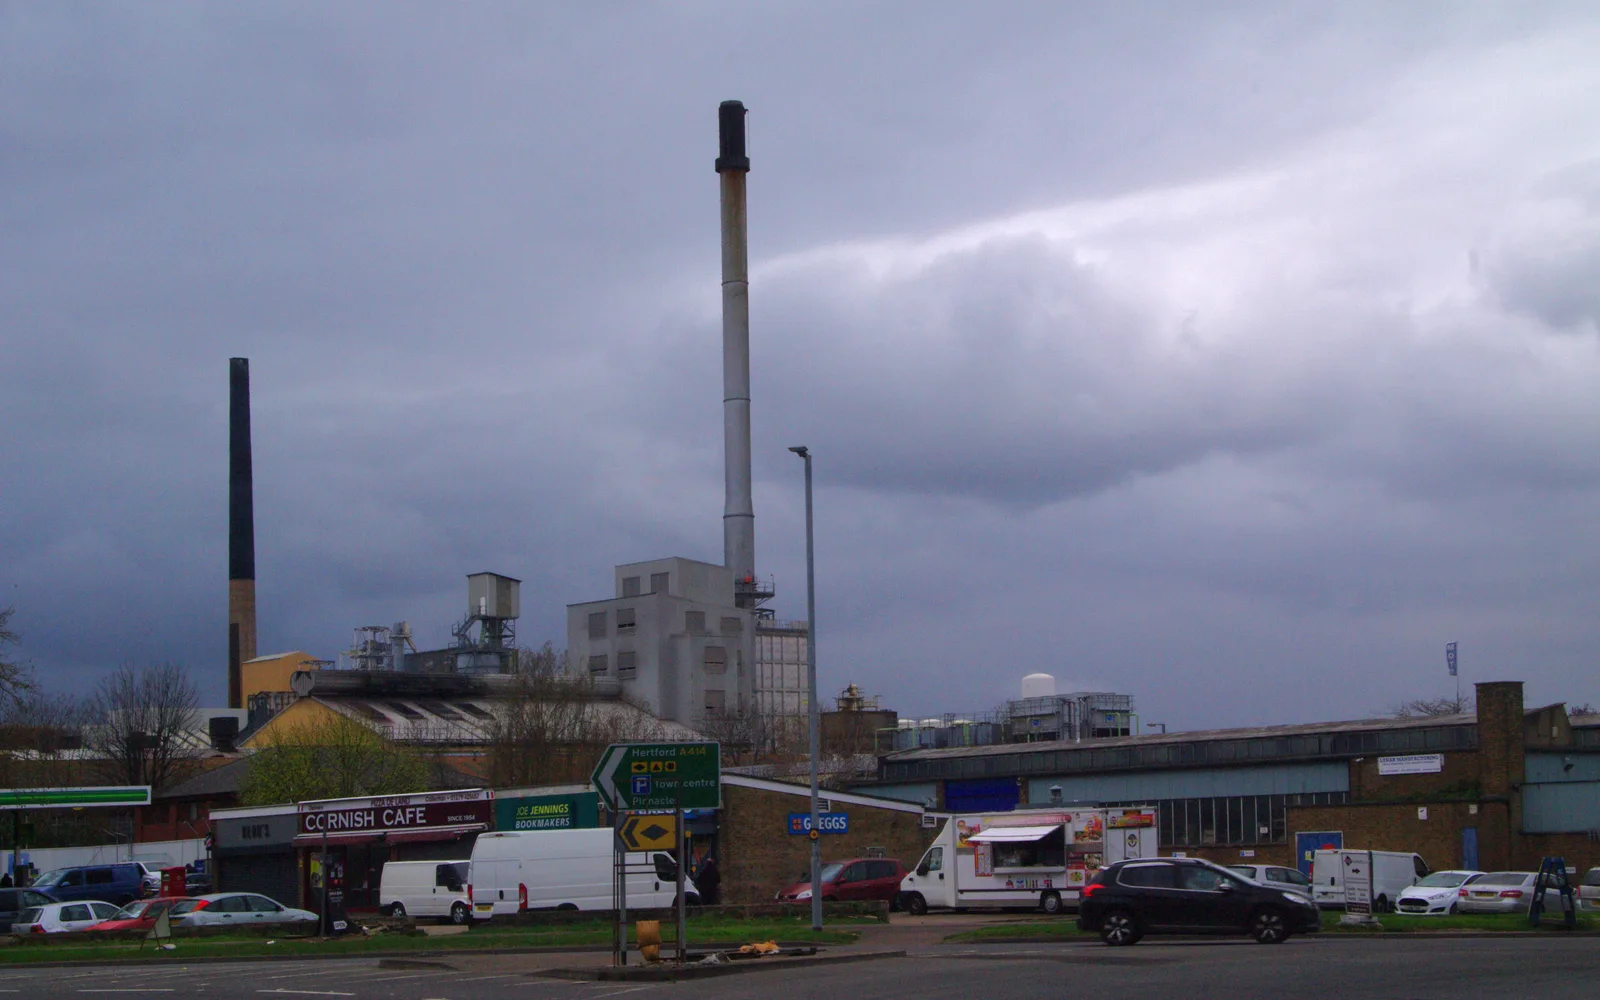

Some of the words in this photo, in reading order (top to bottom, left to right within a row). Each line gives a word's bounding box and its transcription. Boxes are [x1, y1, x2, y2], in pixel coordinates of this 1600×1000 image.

[632, 747, 676, 757] Hertford
[680, 747, 706, 756] A414
[684, 778, 716, 788] centre
[632, 796, 678, 806] Pinnacle
[516, 806, 529, 816] JOE
[530, 804, 569, 815] JENNINGS
[305, 811, 374, 831] CORNISH
[382, 807, 427, 826] CAFE
[515, 818, 570, 829] BOOKMAKERS
[803, 817, 846, 830] GEGGS
